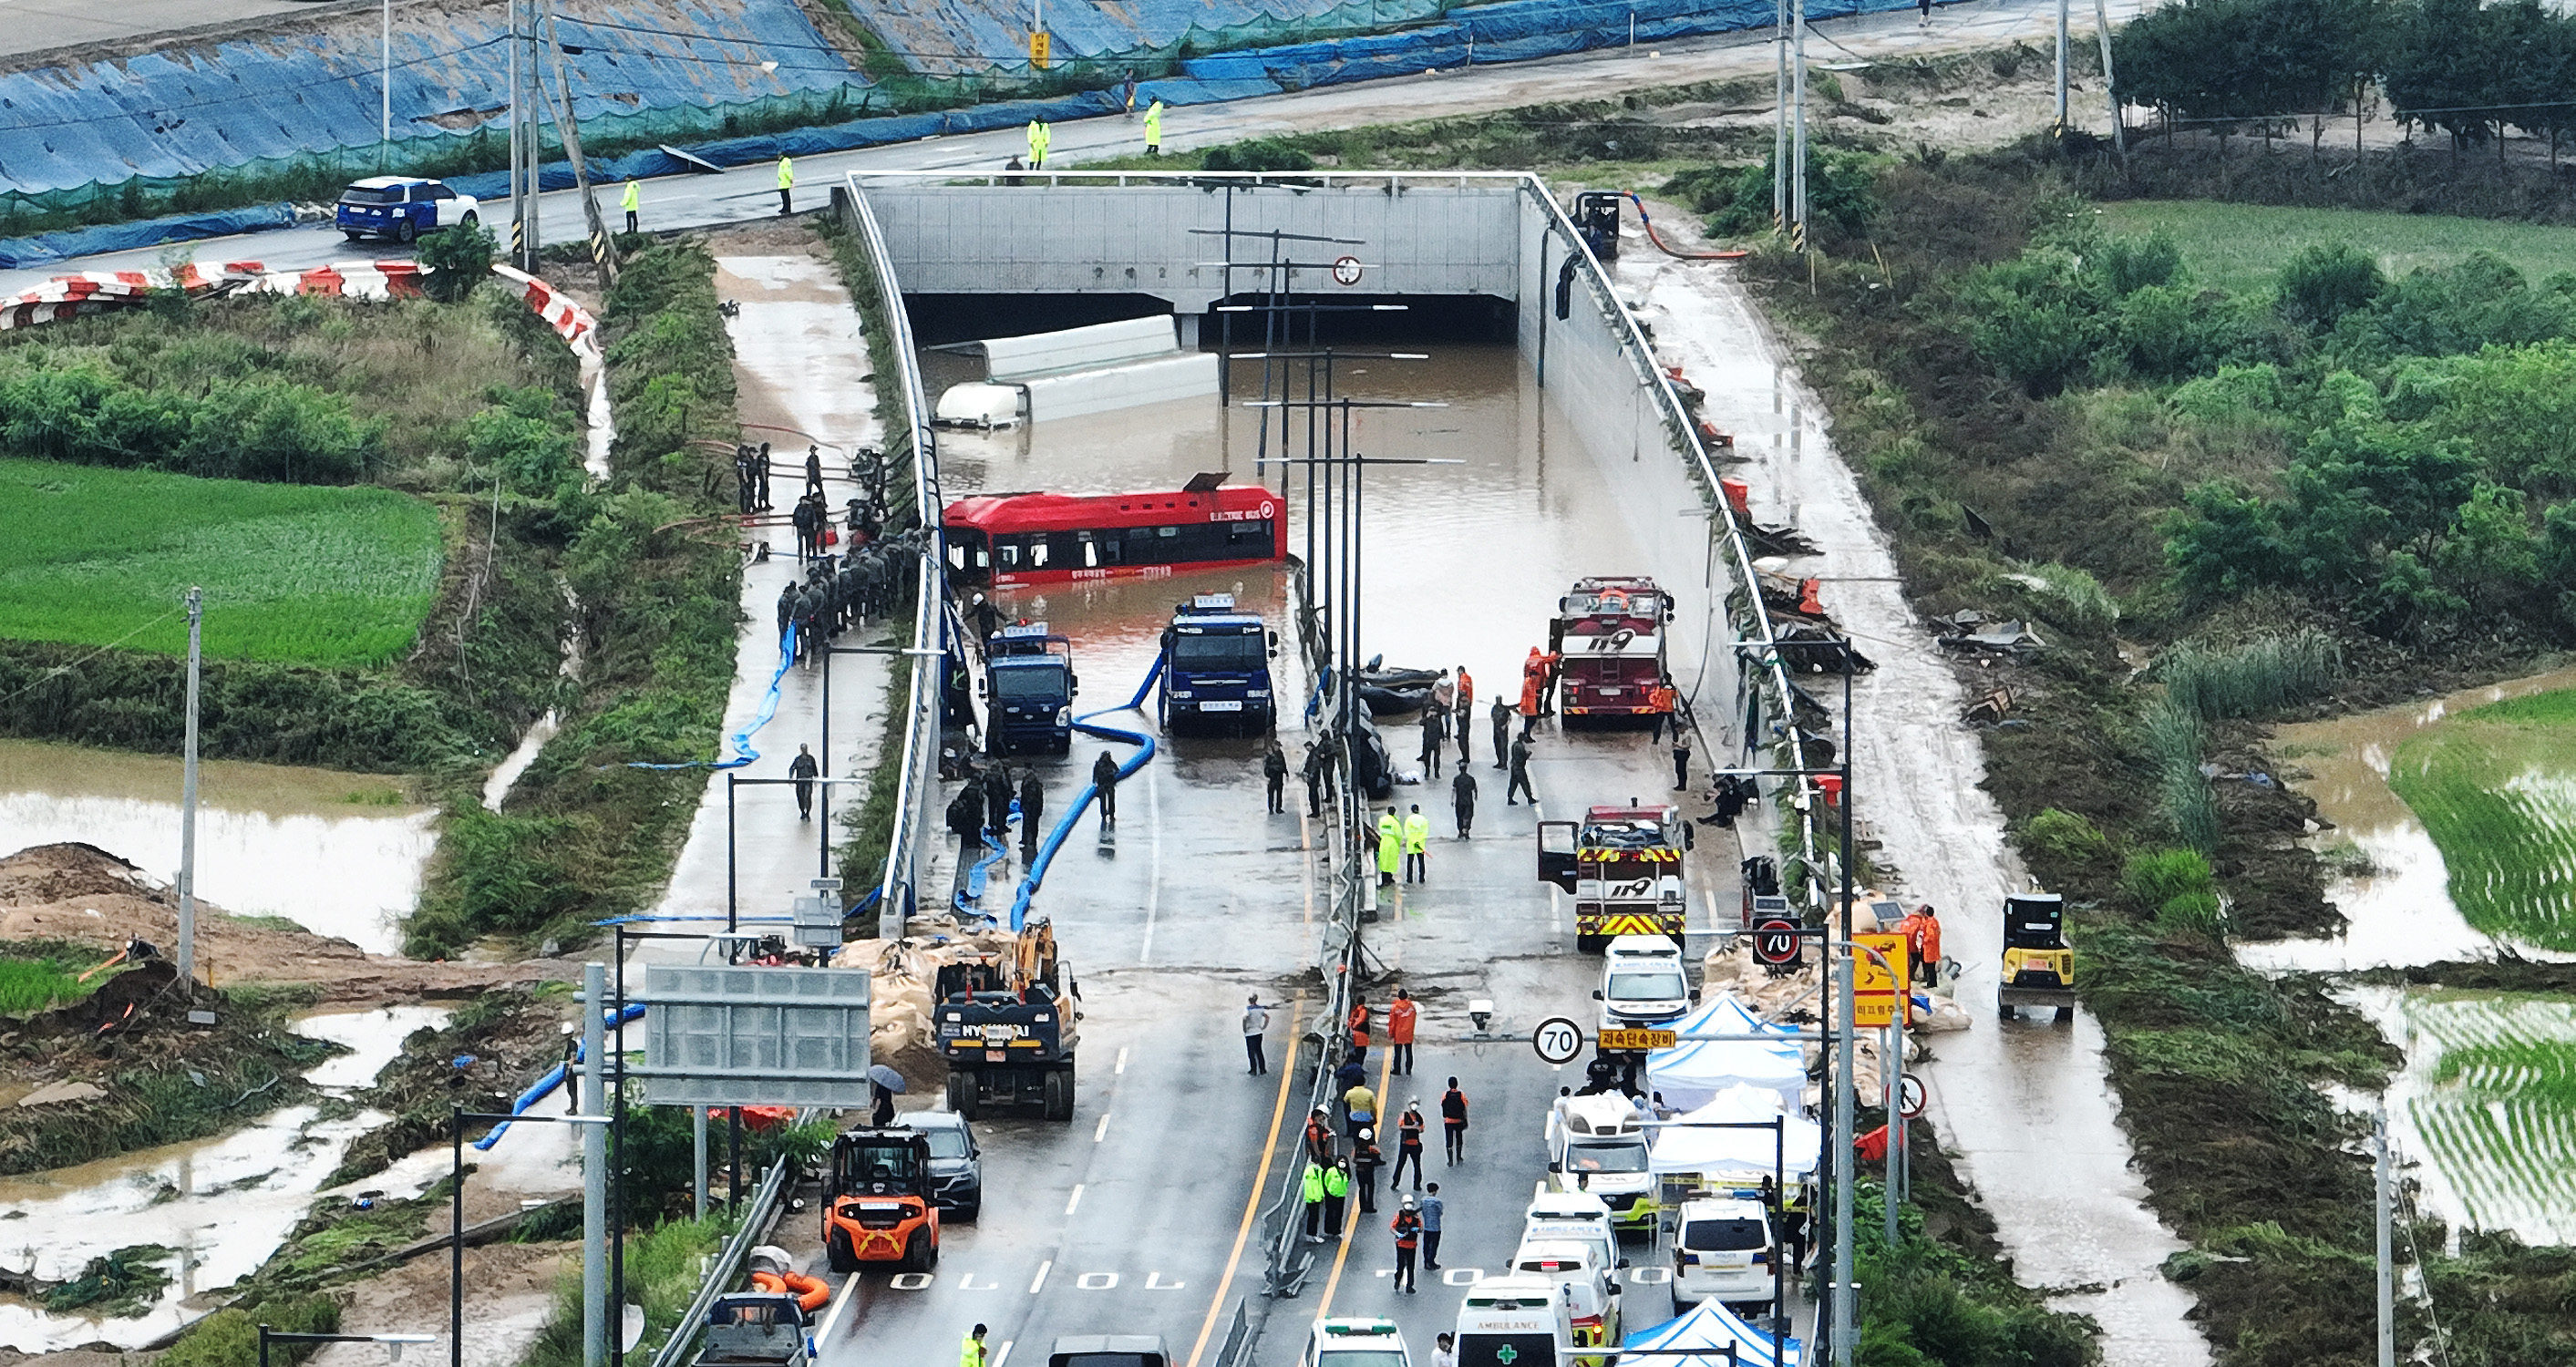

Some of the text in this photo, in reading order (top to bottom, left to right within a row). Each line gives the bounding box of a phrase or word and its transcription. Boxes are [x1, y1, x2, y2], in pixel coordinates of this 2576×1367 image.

[1588, 630, 1634, 651] 119
[1612, 879, 1652, 896] 119
[1544, 1031, 1573, 1053] 70
[1603, 1031, 1672, 1047] 과속단속장비
[1478, 1321, 1540, 1330] AMBULANCE
